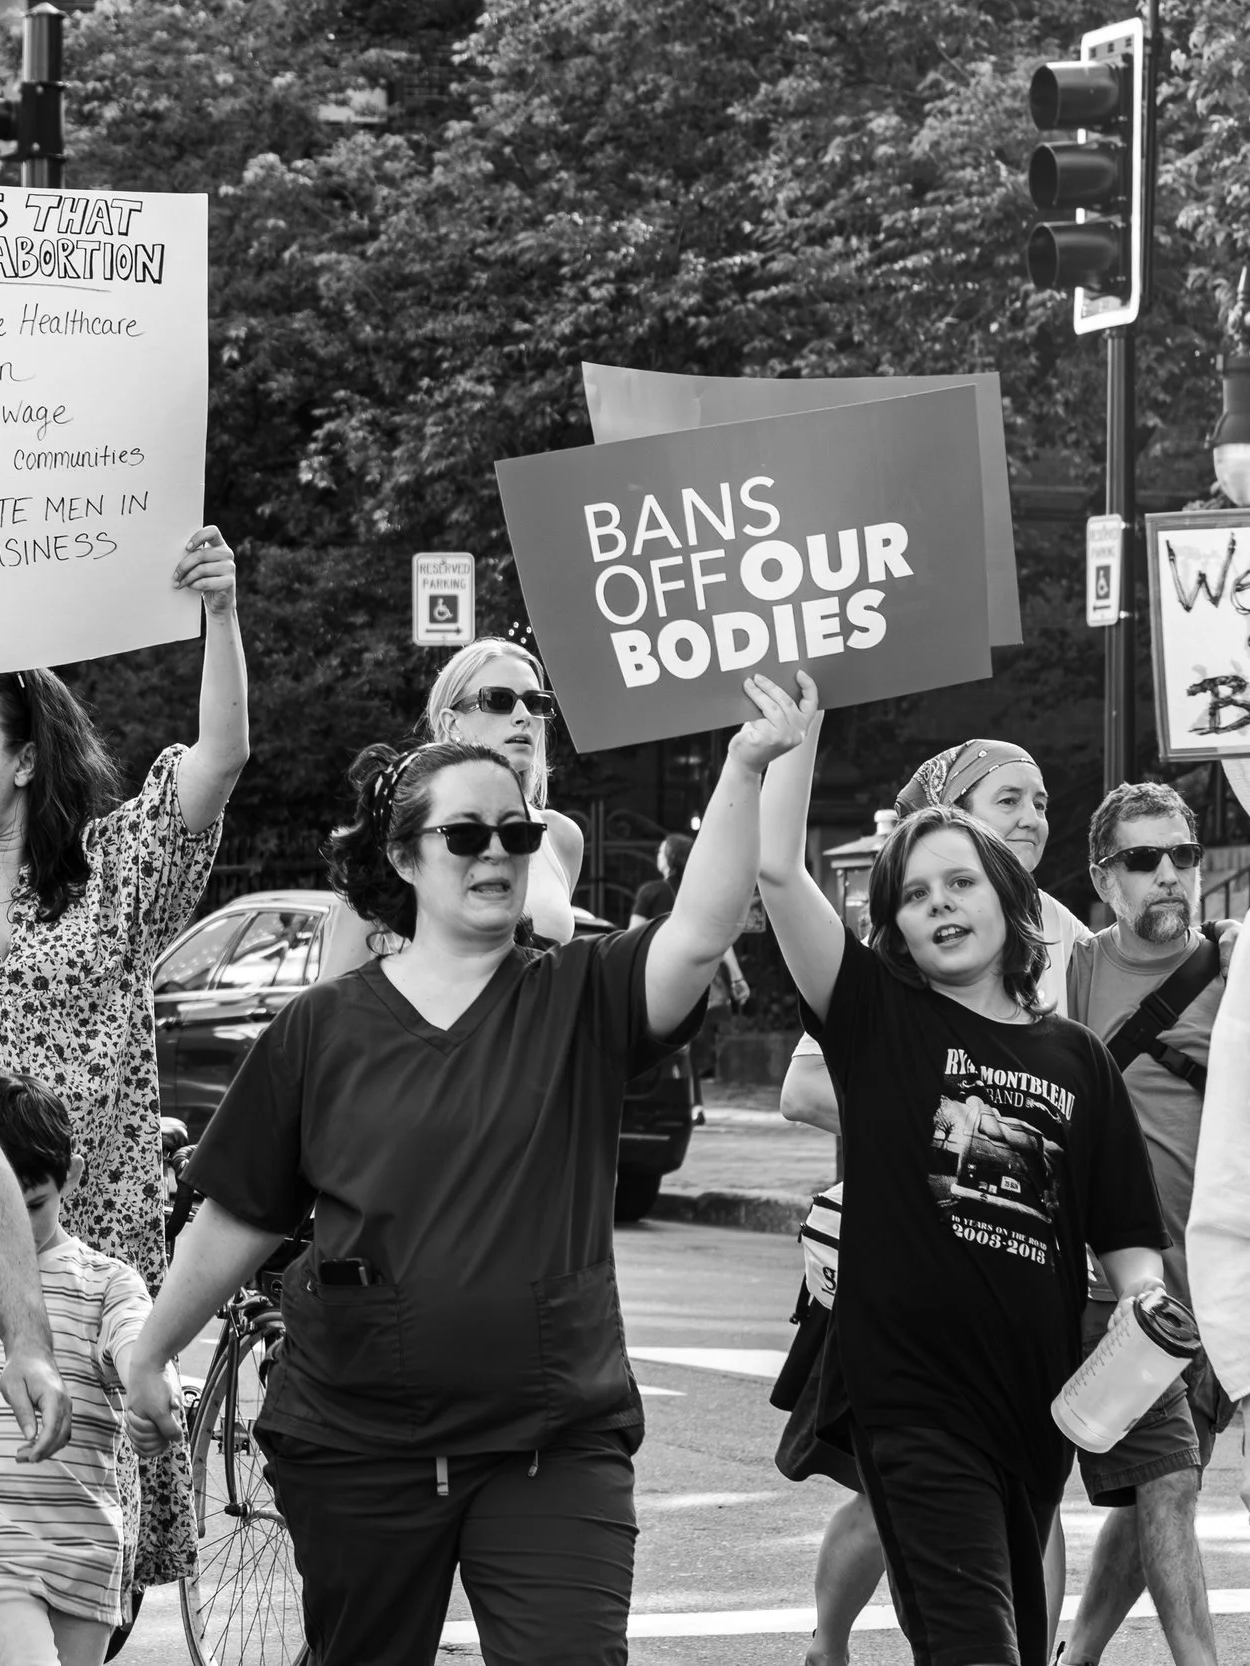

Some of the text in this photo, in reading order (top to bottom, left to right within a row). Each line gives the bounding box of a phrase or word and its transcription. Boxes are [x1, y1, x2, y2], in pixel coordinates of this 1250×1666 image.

[25, 193, 143, 236] THAT
[19, 303, 145, 338] Healthcare
[44, 494, 104, 522] MEN
[121, 491, 148, 515] IN
[584, 476, 781, 562] BANS
[420, 563, 470, 574] RESERVED
[423, 578, 466, 589] PARKING
[595, 522, 914, 625] OFF OUR
[610, 588, 887, 689] BODIES
[944, 1049, 1075, 1120] RYA MONTBLEAU
[952, 1223, 1046, 1265] 2003-2013
[963, 1218, 993, 1231] YEARS
[995, 1226, 1008, 1236] ON
[1011, 1231, 1026, 1242] THE
[1028, 1237, 1047, 1251] ROAD
